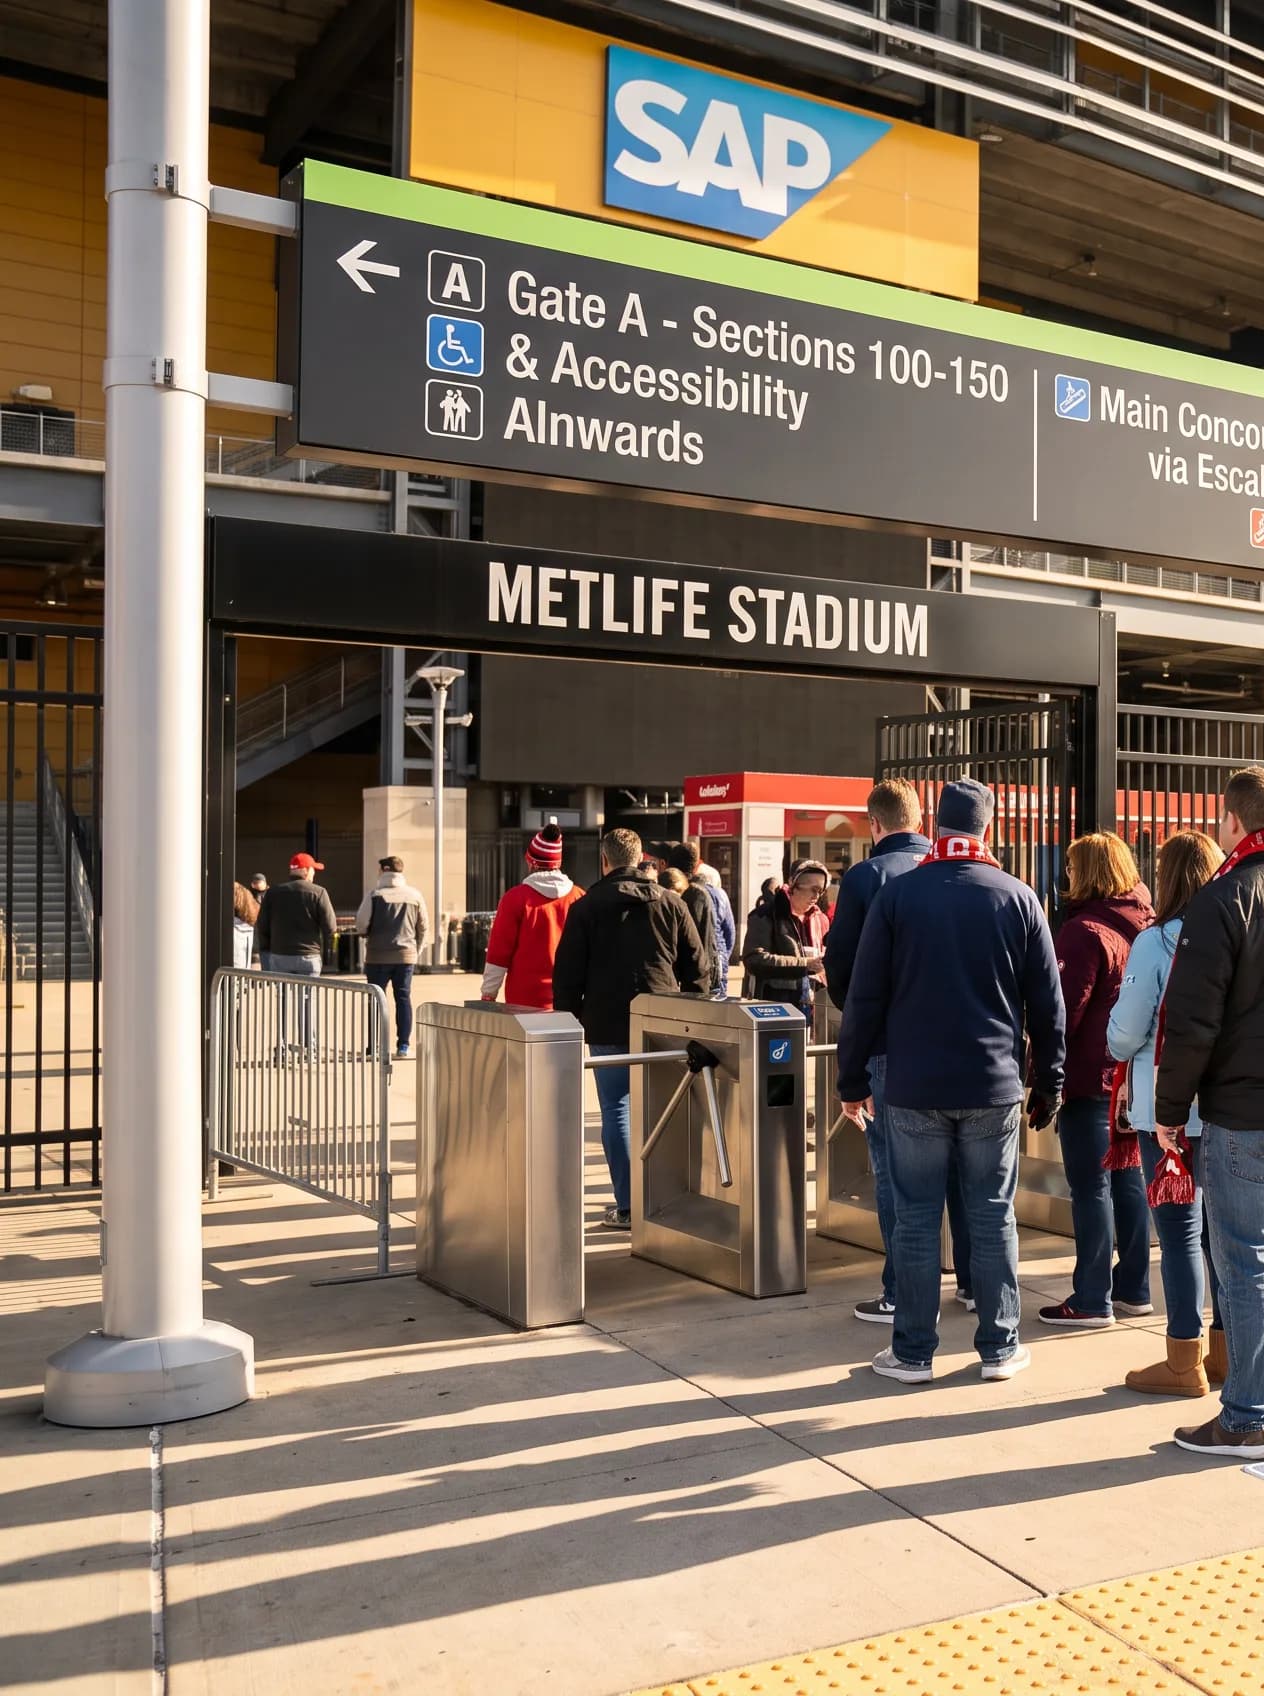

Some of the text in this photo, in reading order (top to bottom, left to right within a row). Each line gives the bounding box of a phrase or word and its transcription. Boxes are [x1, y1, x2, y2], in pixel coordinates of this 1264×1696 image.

[614, 80, 831, 216] SAP
[442, 262, 471, 302] A
[506, 333, 809, 431] & Accessibility
[508, 270, 1009, 403] Gate A - Sections 100-150
[1100, 385, 1168, 433] Main
[1148, 446, 1188, 485] via
[488, 561, 928, 657] METLIFE STADIUM
